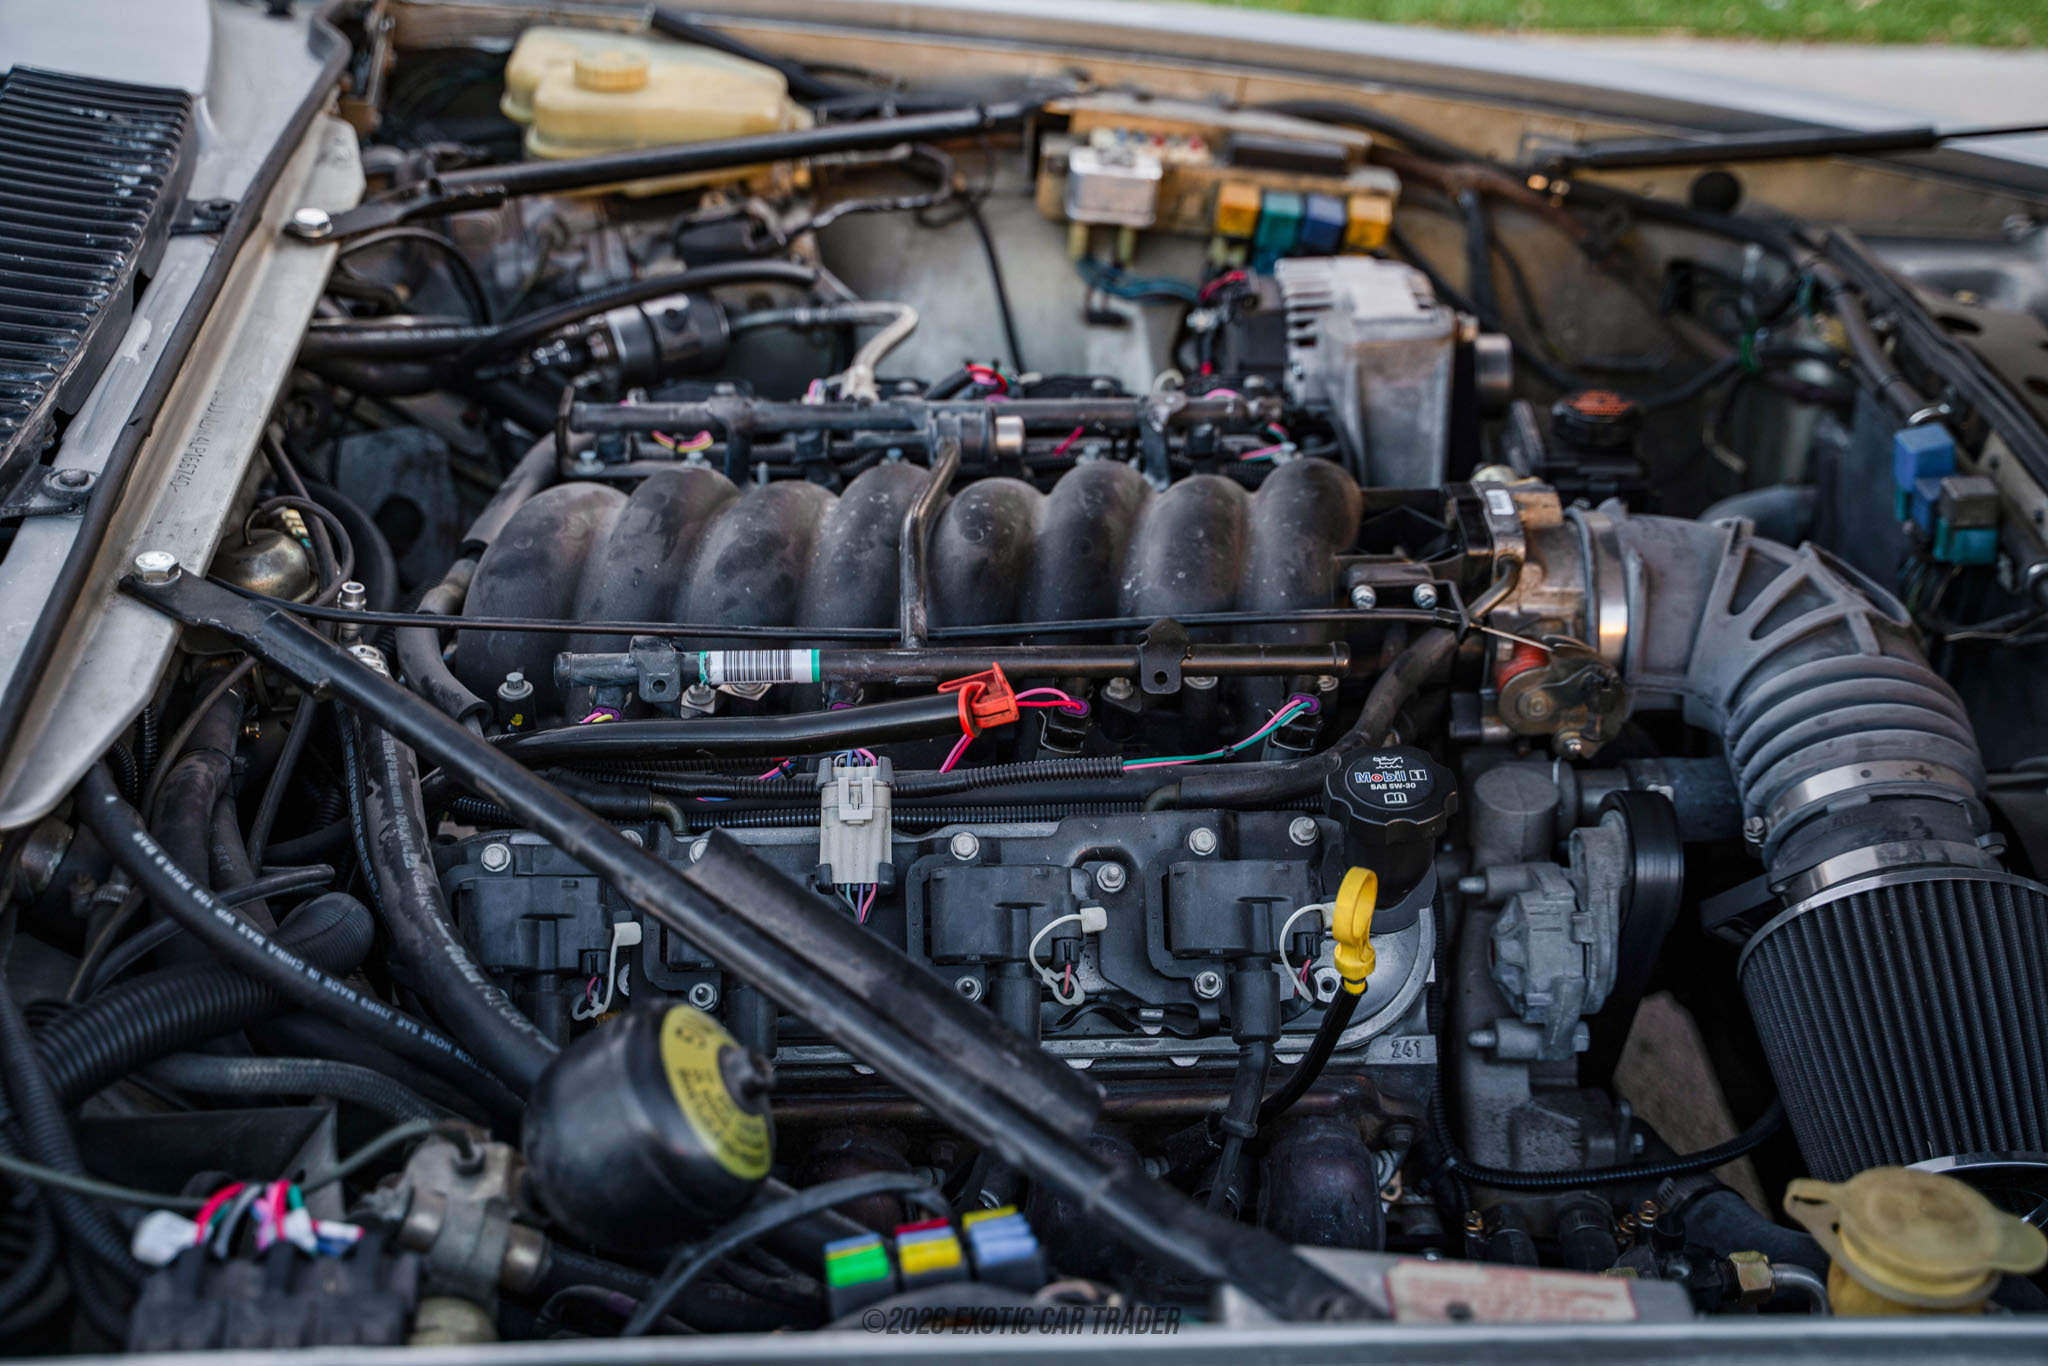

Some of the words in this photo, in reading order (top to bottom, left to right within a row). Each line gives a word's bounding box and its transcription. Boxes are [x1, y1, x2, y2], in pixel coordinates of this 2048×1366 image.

[1354, 770, 1407, 783] Mobil
[238, 922, 266, 947] MAX
[267, 941, 305, 971] CHINA
[307, 966, 321, 982] IN
[323, 975, 358, 1002] MADE
[1391, 1039, 1422, 1058] 241
